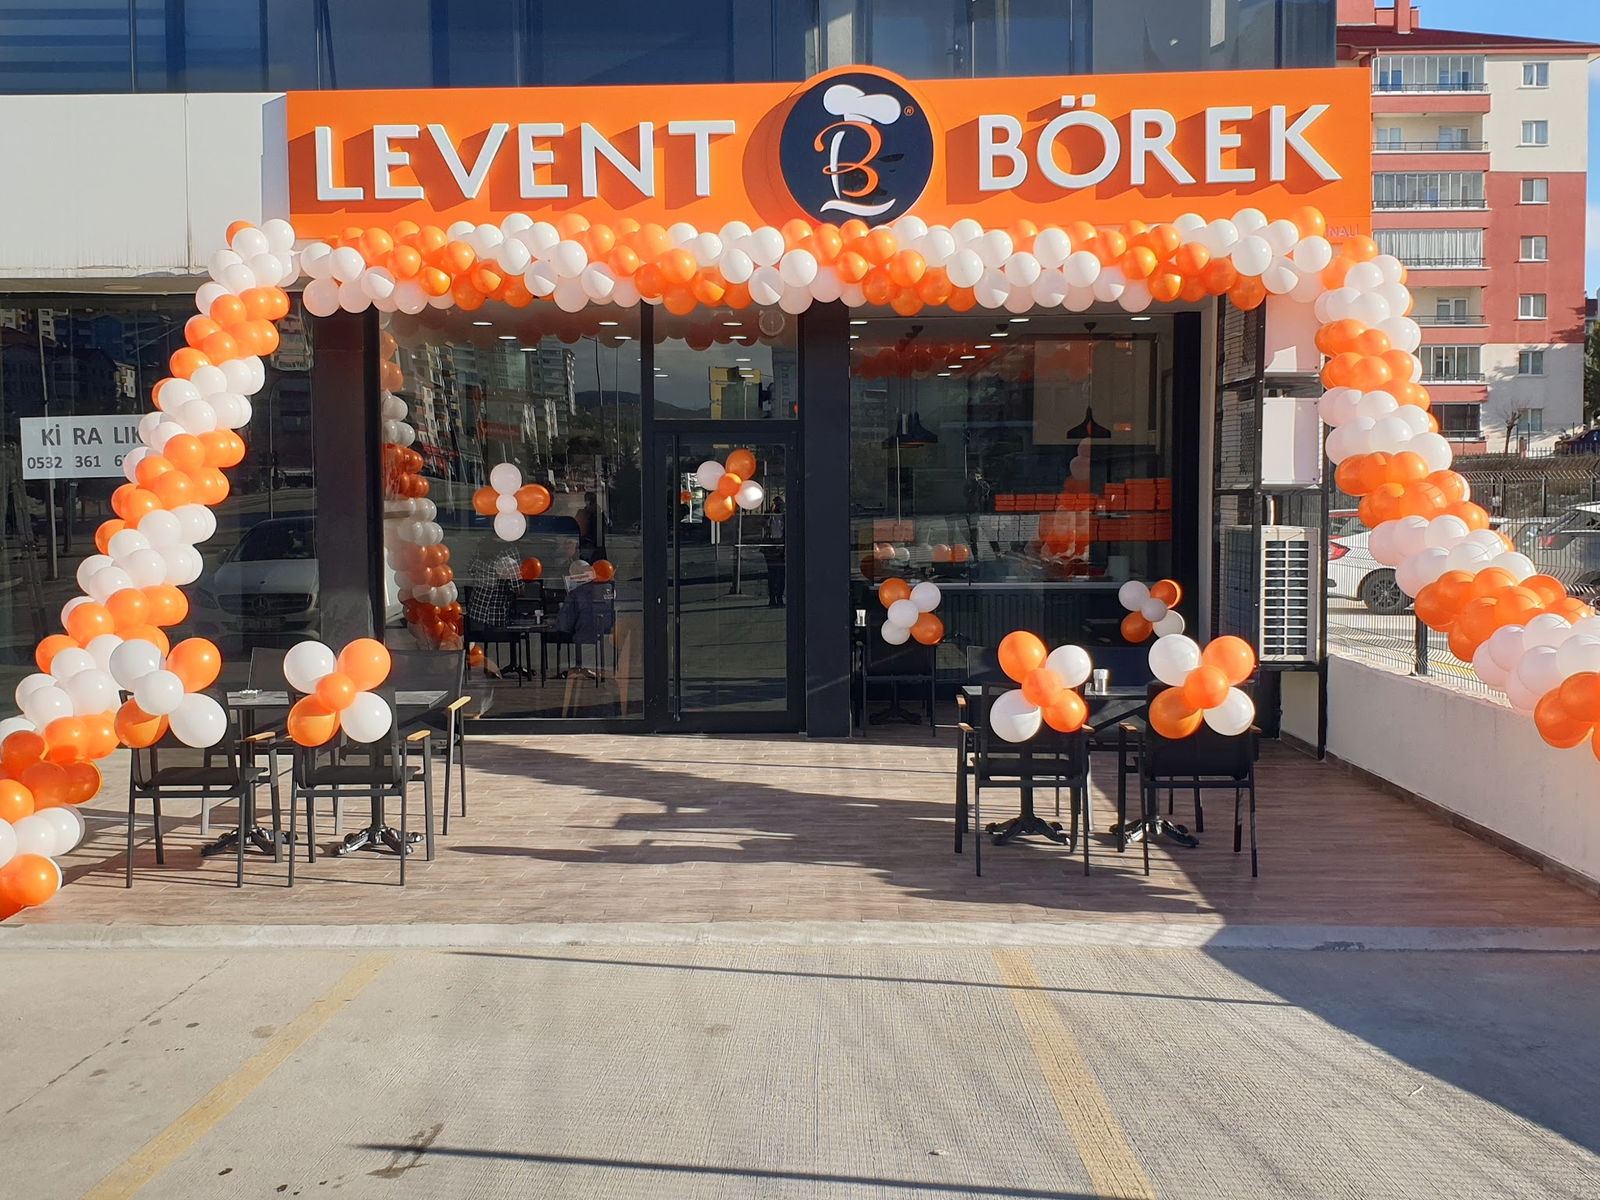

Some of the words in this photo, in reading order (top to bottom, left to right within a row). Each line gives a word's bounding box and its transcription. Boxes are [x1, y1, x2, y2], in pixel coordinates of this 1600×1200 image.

[314, 120, 736, 202] LEVENT
[977, 94, 1342, 192] BÖREK
[73, 427, 103, 445] RA
[27, 456, 62, 469] 0532
[75, 455, 102, 468] 361
